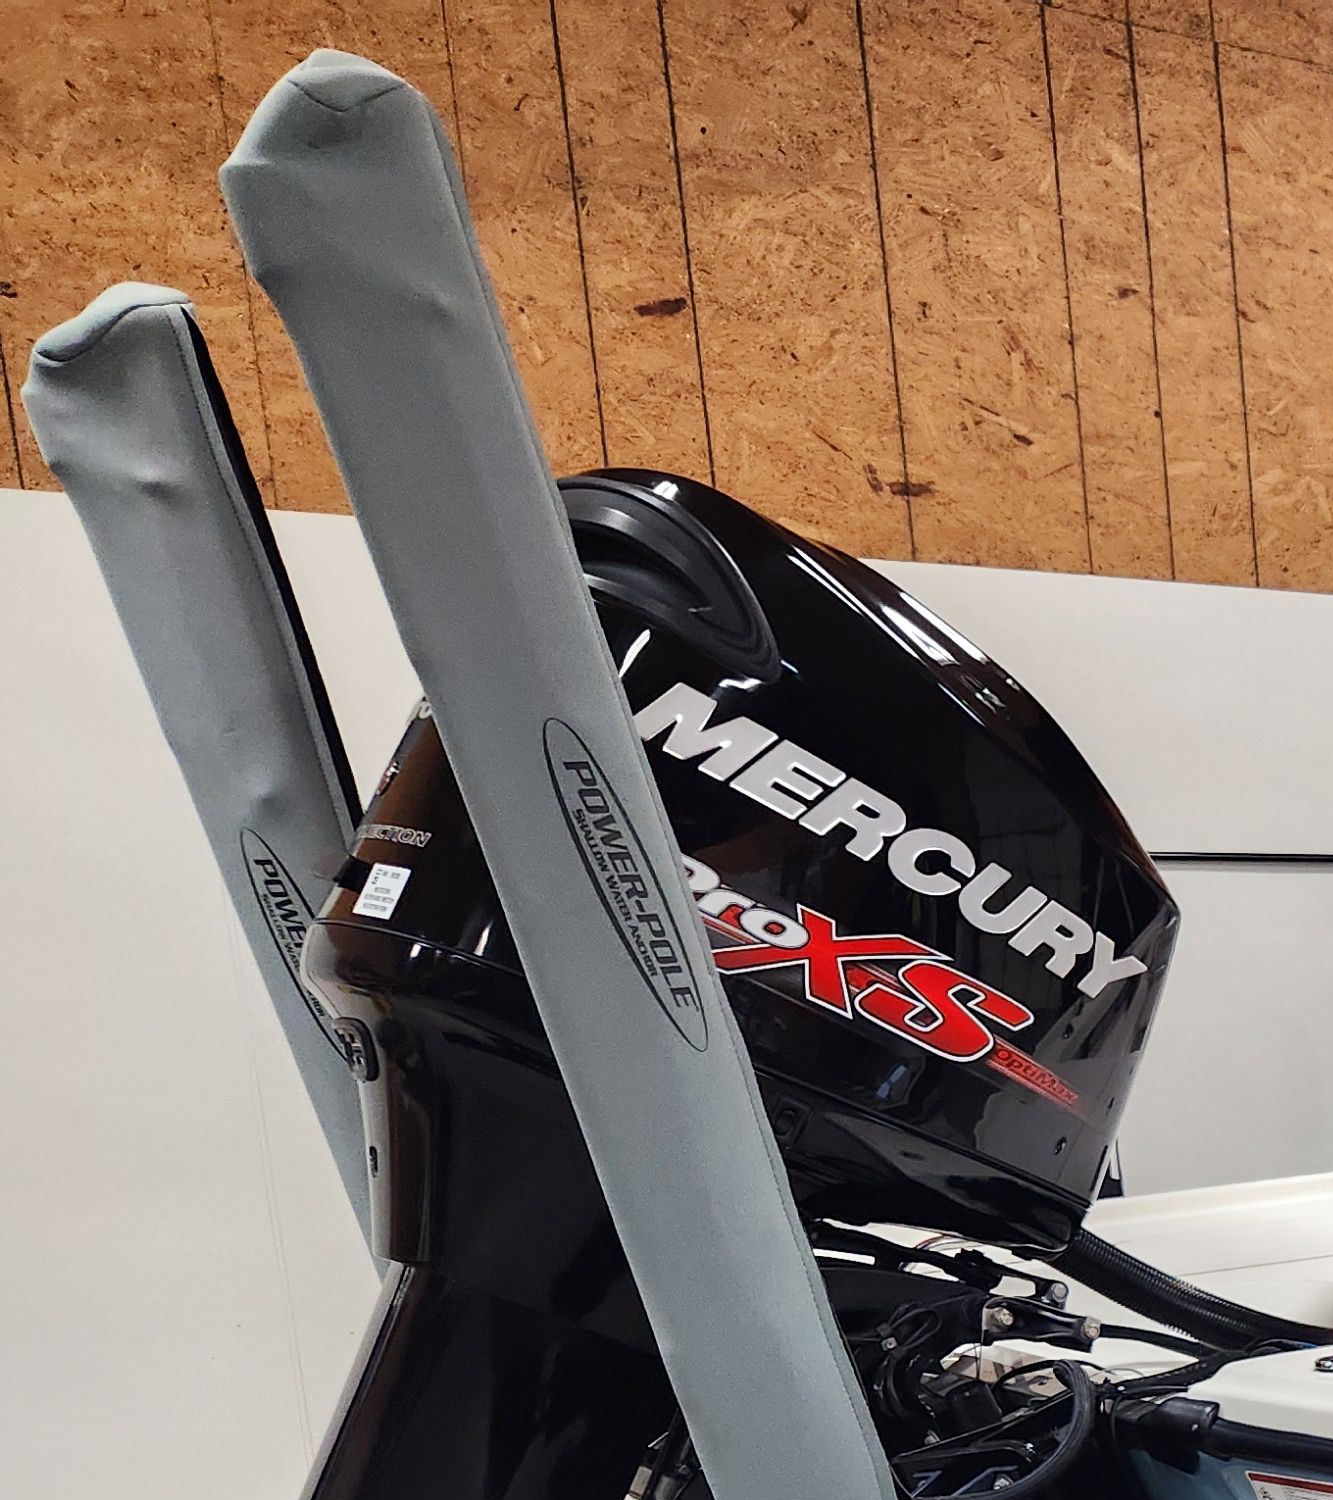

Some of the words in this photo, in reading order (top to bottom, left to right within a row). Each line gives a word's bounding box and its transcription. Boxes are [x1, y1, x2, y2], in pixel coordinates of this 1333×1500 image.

[562, 760, 699, 1008] POWER-POLE
[572, 808, 611, 873] SHALLOW
[606, 875, 632, 923] WATER
[628, 923, 659, 978] ANCHOR
[632, 681, 1149, 1000] MERCURY
